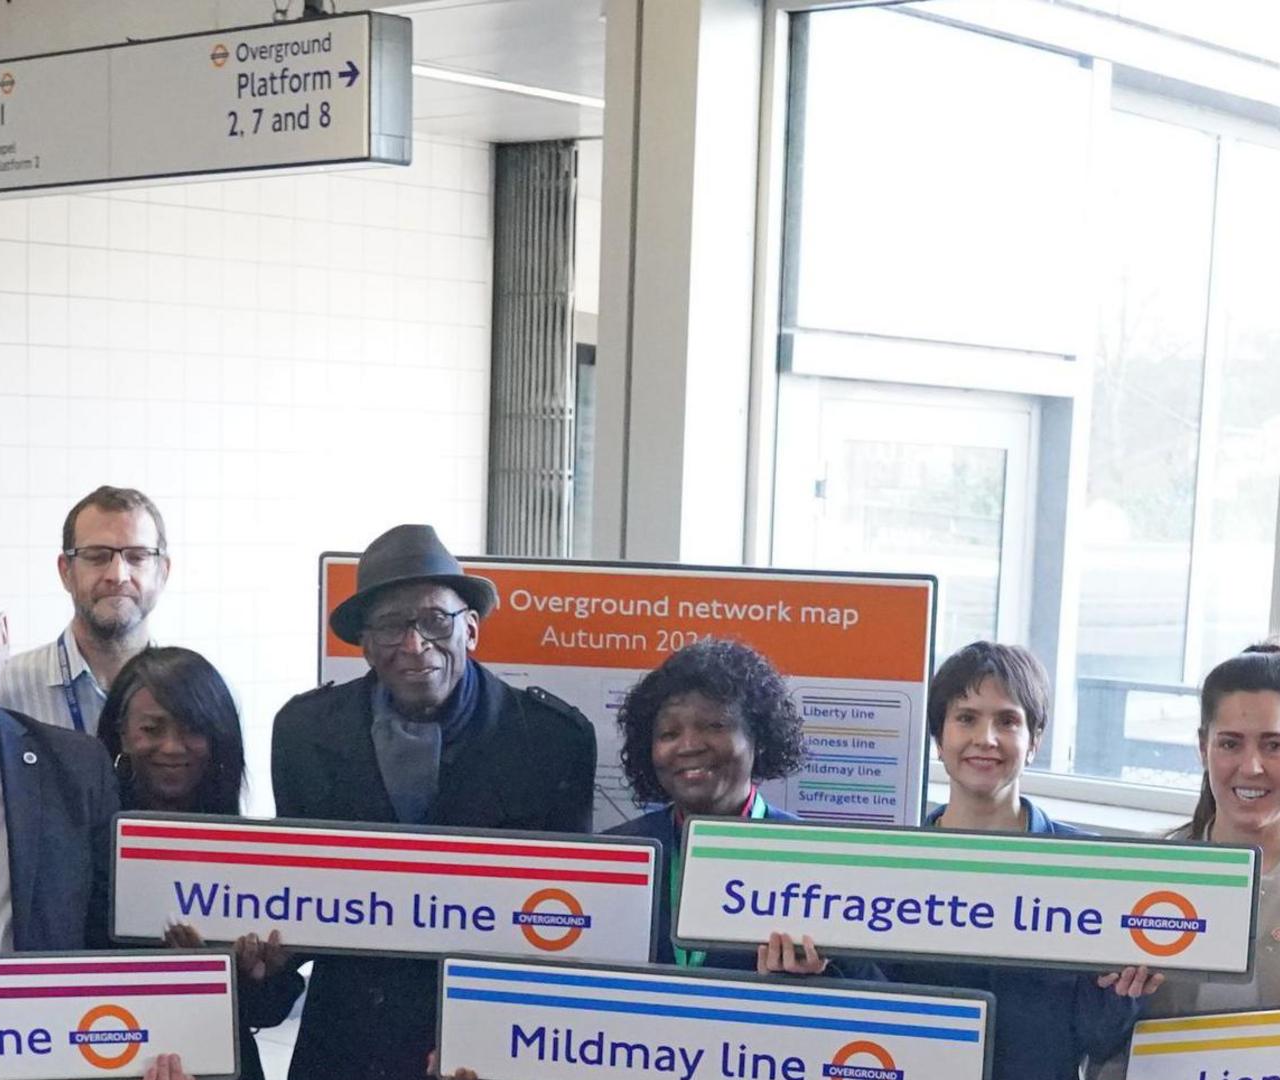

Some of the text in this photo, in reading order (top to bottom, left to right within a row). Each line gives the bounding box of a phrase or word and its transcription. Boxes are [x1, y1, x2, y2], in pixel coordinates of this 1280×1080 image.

[236, 32, 331, 63] Overground
[238, 67, 331, 99] Platform
[228, 101, 331, 137] 2, 7 and 8
[510, 589, 669, 619] Overground
[678, 598, 792, 622] network
[800, 604, 859, 630] map
[541, 625, 711, 652] Autumn 202
[803, 706, 875, 720] Liberty line
[852, 738, 875, 749] line
[858, 765, 881, 776] line
[799, 790, 896, 805] Suffragette line
[174, 881, 496, 931] Windrush line
[722, 879, 1104, 936] Suffragette line
[518, 914, 586, 926] OVERGROUND
[1127, 917, 1200, 930] OVERGROUND
[75, 1030, 143, 1043] OVERGROUND
